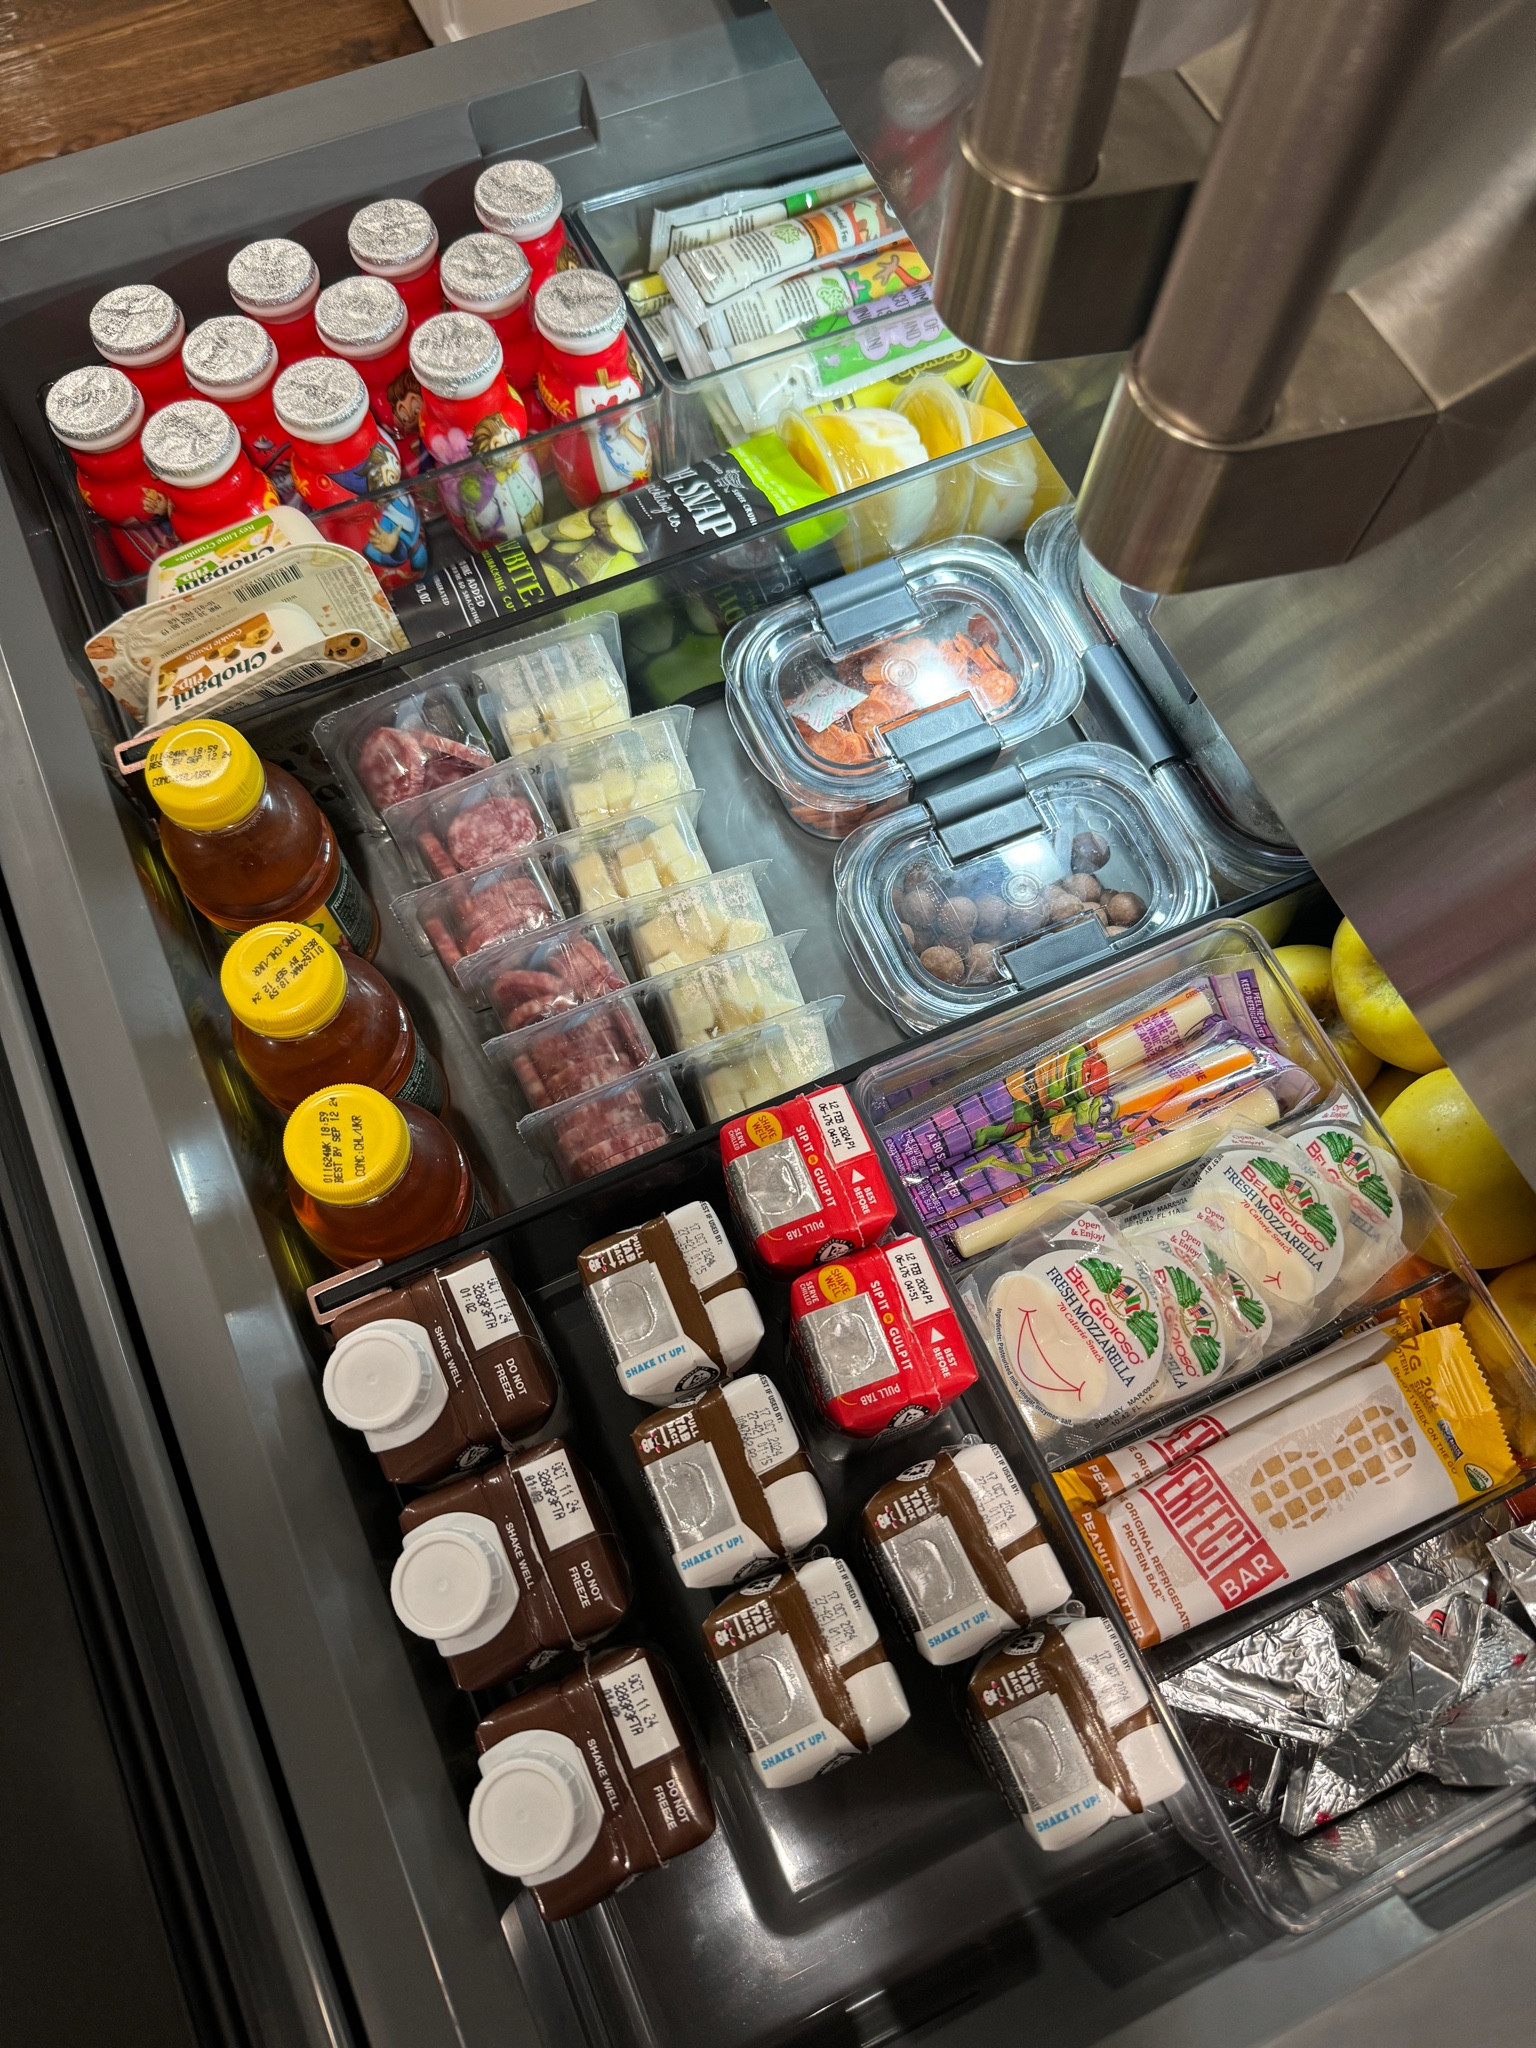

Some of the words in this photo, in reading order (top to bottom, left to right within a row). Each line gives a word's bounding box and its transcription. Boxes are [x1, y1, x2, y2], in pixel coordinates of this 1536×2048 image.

[674, 481, 737, 537] SNAP
[462, 590, 482, 624] SNACKING
[467, 578, 486, 608] ADDED
[214, 628, 243, 645] Cookie
[185, 644, 213, 661] Dough
[172, 651, 266, 711] Chobani
[289, 956, 299, 967] BY
[300, 938, 319, 957] BEST
[262, 982, 273, 993] 12
[276, 968, 288, 982] SEP
[1241, 978, 1251, 997] KEEP
[252, 992, 262, 1004] 24
[1245, 997, 1266, 1039] REFRIGERATED
[330, 1112, 339, 1121] 12
[828, 1101, 839, 1109] 12
[832, 1111, 845, 1124] FEB
[319, 1112, 331, 1136] 18:59
[331, 1127, 341, 1142] SEP
[734, 1127, 746, 1149] SERVE
[752, 1122, 769, 1143] WELL
[758, 1115, 777, 1140] SHAKE
[827, 1128, 842, 1148] 04:51
[333, 1146, 342, 1157] BY
[333, 1162, 344, 1184] BEST
[796, 1125, 809, 1145] SIP
[803, 1143, 815, 1153] IT
[813, 1168, 831, 1194] GULP
[825, 1194, 837, 1207] IT
[853, 1186, 870, 1215] BEFORE
[864, 1186, 877, 1205] BEST
[1240, 1164, 1326, 1253] BELGIOIOSO
[802, 1219, 825, 1235] PULL
[1077, 1218, 1100, 1232] Open
[1223, 1166, 1261, 1204] FRESH
[1254, 1198, 1323, 1272] MOZZARELLA
[1240, 1199, 1250, 1209] 70
[1249, 1206, 1272, 1235] Calorie
[1271, 1232, 1293, 1255] Snack
[632, 1233, 644, 1259] PULL
[785, 1228, 805, 1240] TAB
[1181, 1229, 1202, 1246] Open
[620, 1241, 636, 1263] TAB
[905, 1252, 916, 1261] 12
[1178, 1239, 1202, 1259] Enjoy!
[831, 1268, 851, 1295] SHAKE
[910, 1263, 922, 1278] FEB
[806, 1280, 820, 1304] SERVE
[824, 1276, 841, 1298] WELL
[904, 1281, 919, 1302] 04:51
[870, 1280, 885, 1300] SIP
[878, 1299, 890, 1311] IT
[889, 1327, 907, 1356] GULP
[901, 1355, 914, 1370] IT
[1046, 1266, 1079, 1313] FRESH
[1072, 1308, 1136, 1388] MOZZARELLA
[1065, 1265, 1141, 1365] BELGIOIOSO
[1056, 1301, 1067, 1313] 70
[1062, 1311, 1086, 1340] Calorie
[1085, 1336, 1104, 1364] Snack
[435, 1326, 452, 1360] SHAKE
[447, 1360, 462, 1388] WELL
[625, 1357, 656, 1379] SHAKE
[657, 1352, 666, 1364] IT
[668, 1345, 686, 1360] UP!
[932, 1347, 951, 1378] BEFORE
[943, 1347, 957, 1367] BEST
[494, 1363, 515, 1401] FREEZE
[506, 1358, 518, 1373] DO
[512, 1375, 527, 1395] NOT
[878, 1383, 901, 1398] PULL
[768, 1395, 779, 1411] USED
[775, 1411, 784, 1423] BY:
[860, 1392, 880, 1406] TAB
[676, 1416, 691, 1443] TAB
[687, 1410, 699, 1439] PULL
[1412, 1400, 1429, 1425] WEEK
[1427, 1427, 1439, 1440] ON
[1436, 1438, 1449, 1460] THE
[1002, 1466, 1014, 1483] USED
[1011, 1483, 1020, 1495] BY:
[908, 1490, 927, 1518] TAB
[918, 1484, 933, 1513] PULL
[505, 1522, 524, 1559] SHAKE
[518, 1559, 535, 1590] WELL
[680, 1550, 713, 1571] SHAKE
[714, 1544, 724, 1556] IT
[726, 1535, 745, 1550] UP!
[1122, 1522, 1150, 1573] PROTEIN
[1080, 1511, 1117, 1575] PEANUT
[1111, 1576, 1146, 1640] BUTTER
[1125, 1502, 1153, 1557] ORIGINAL
[1151, 1556, 1192, 1630] REFRIGERATE
[1220, 1553, 1274, 1602] BAR
[568, 1566, 591, 1609] FREEZE
[581, 1560, 594, 1577] DO
[588, 1578, 603, 1601] NOT
[749, 1606, 768, 1634] TAB
[760, 1601, 776, 1629] PULL
[928, 1625, 960, 1648] SHAKE
[961, 1620, 972, 1632] IT
[973, 1609, 990, 1626] UP!
[1017, 1665, 1036, 1694] TAB
[1027, 1661, 1044, 1690] PULL
[761, 1748, 793, 1771] SHAKE
[795, 1741, 806, 1753] IT
[808, 1730, 828, 1747] UP!
[587, 1738, 608, 1778] SHAKE
[602, 1778, 621, 1811] WELL
[652, 1785, 678, 1830] FREEZE
[665, 1778, 679, 1796] DO
[673, 1799, 690, 1822] NOT
[1035, 1808, 1069, 1833] SHAKE
[1070, 1803, 1082, 1815] IT
[1083, 1793, 1103, 1810] UP!
